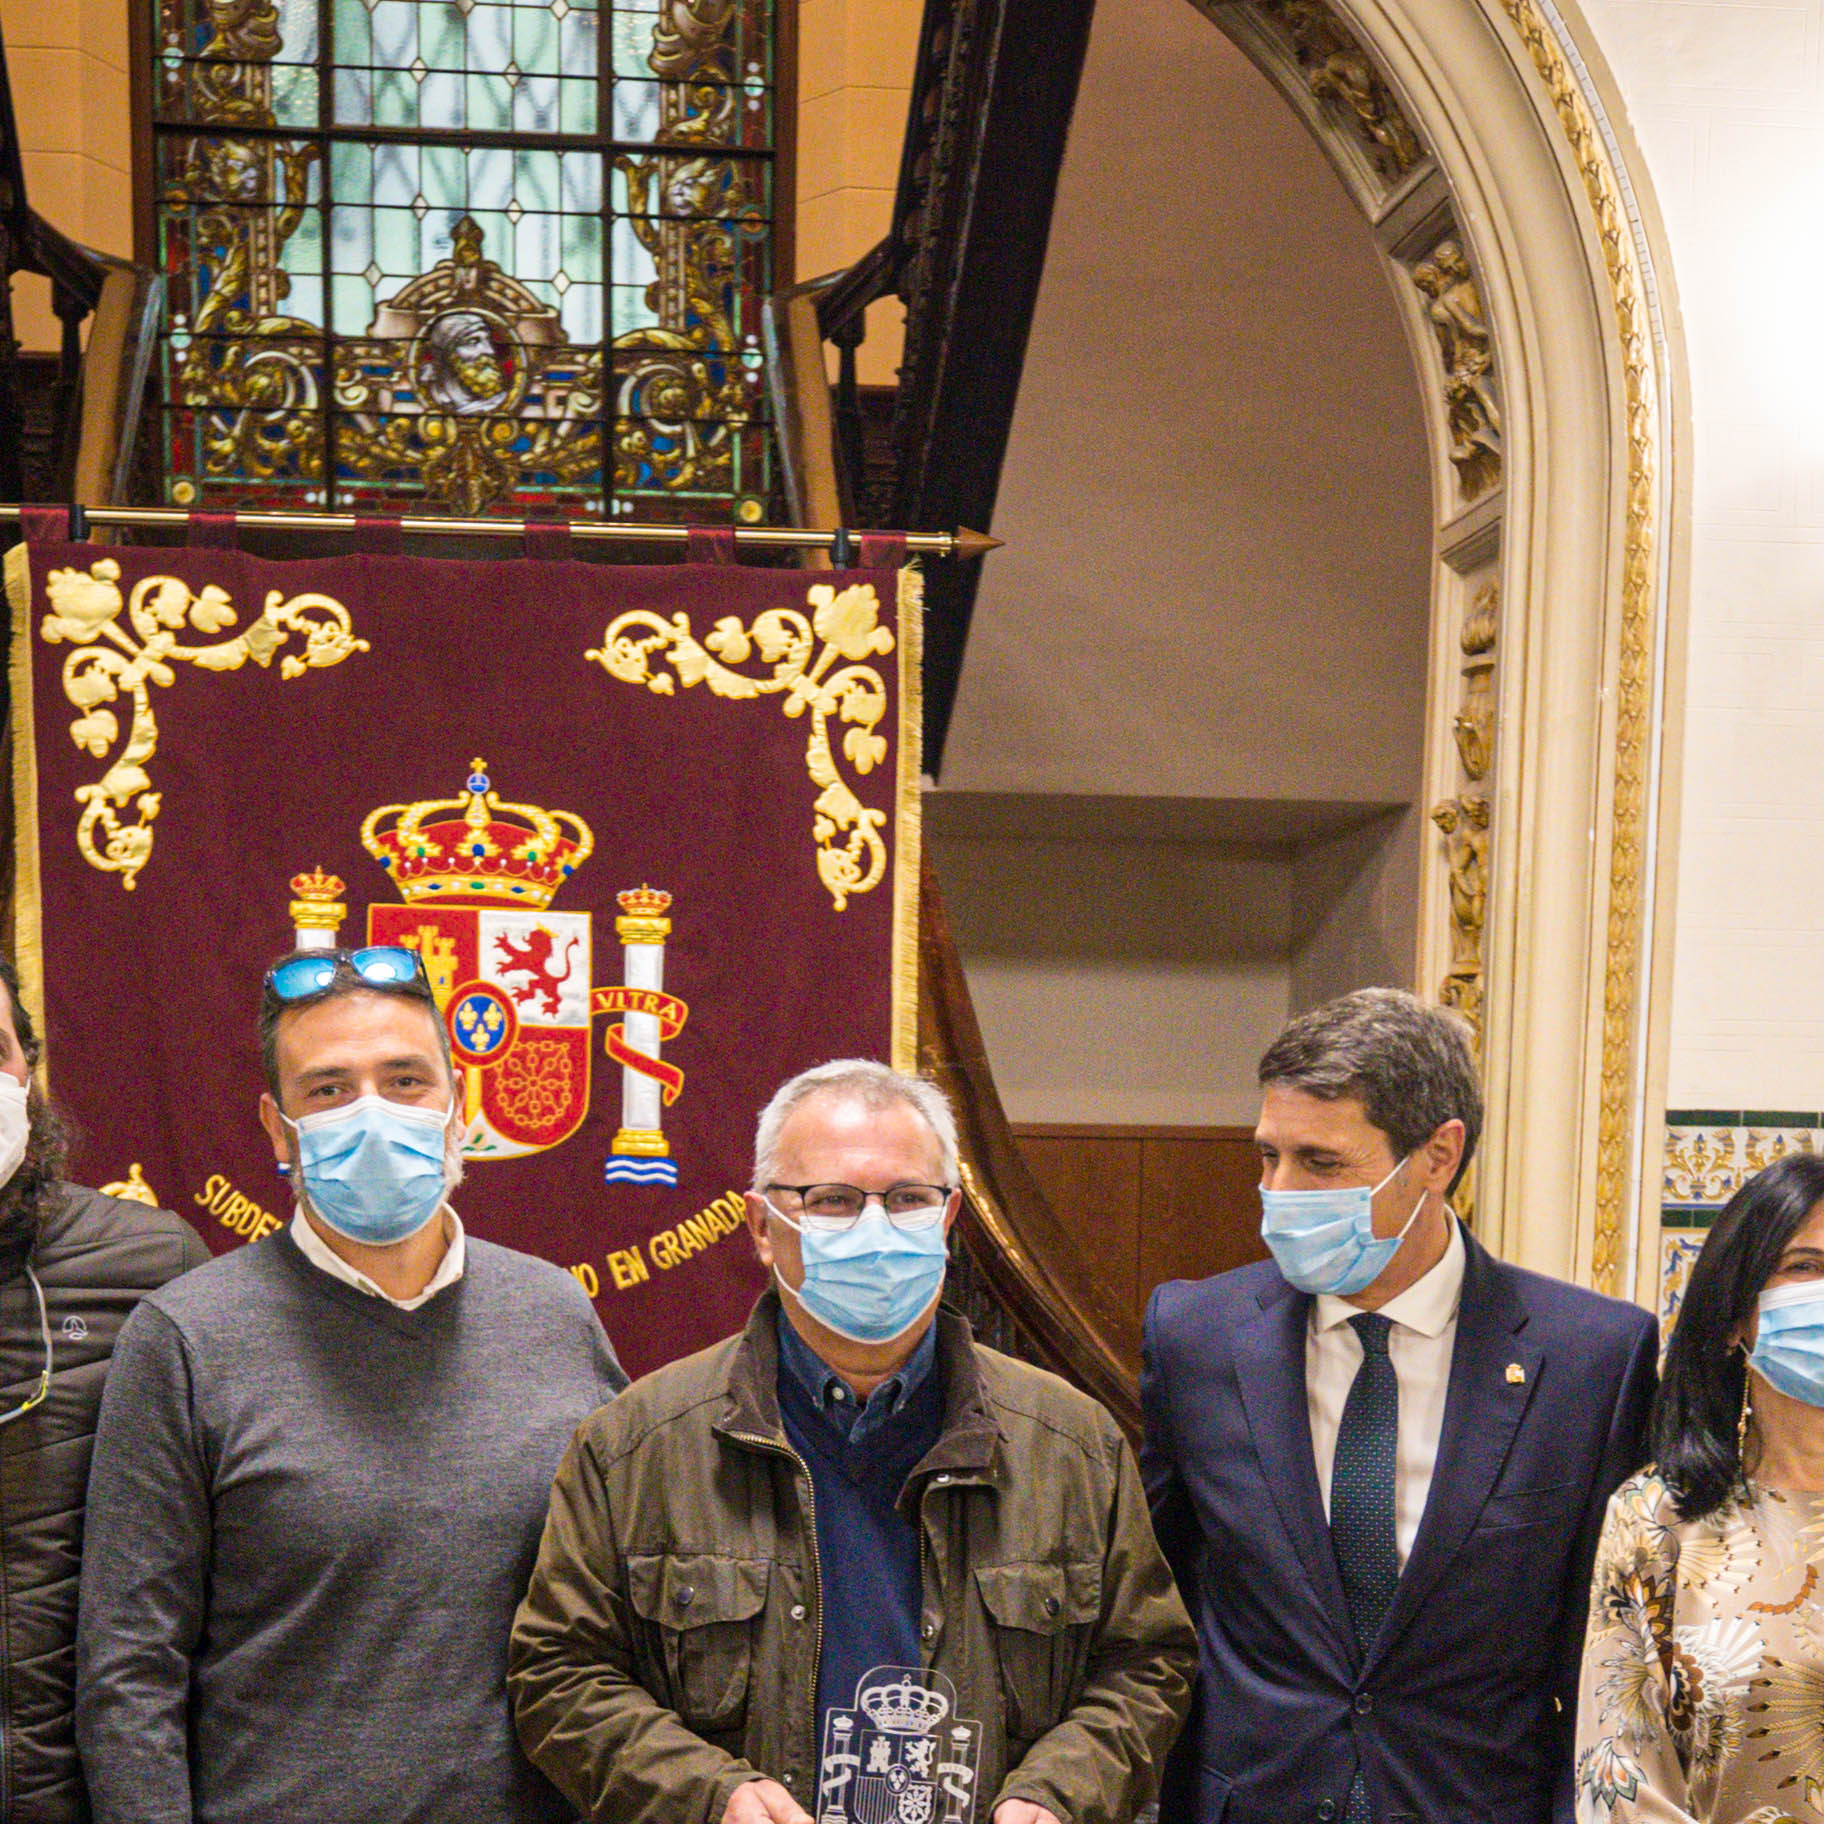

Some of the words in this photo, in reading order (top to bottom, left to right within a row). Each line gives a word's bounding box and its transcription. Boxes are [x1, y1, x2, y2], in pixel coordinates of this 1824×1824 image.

[596, 991, 675, 1020] VLTRA
[194, 1174, 283, 1243] SUBDE
[607, 1245, 650, 1289] EN
[649, 1190, 747, 1270] GRANADA
